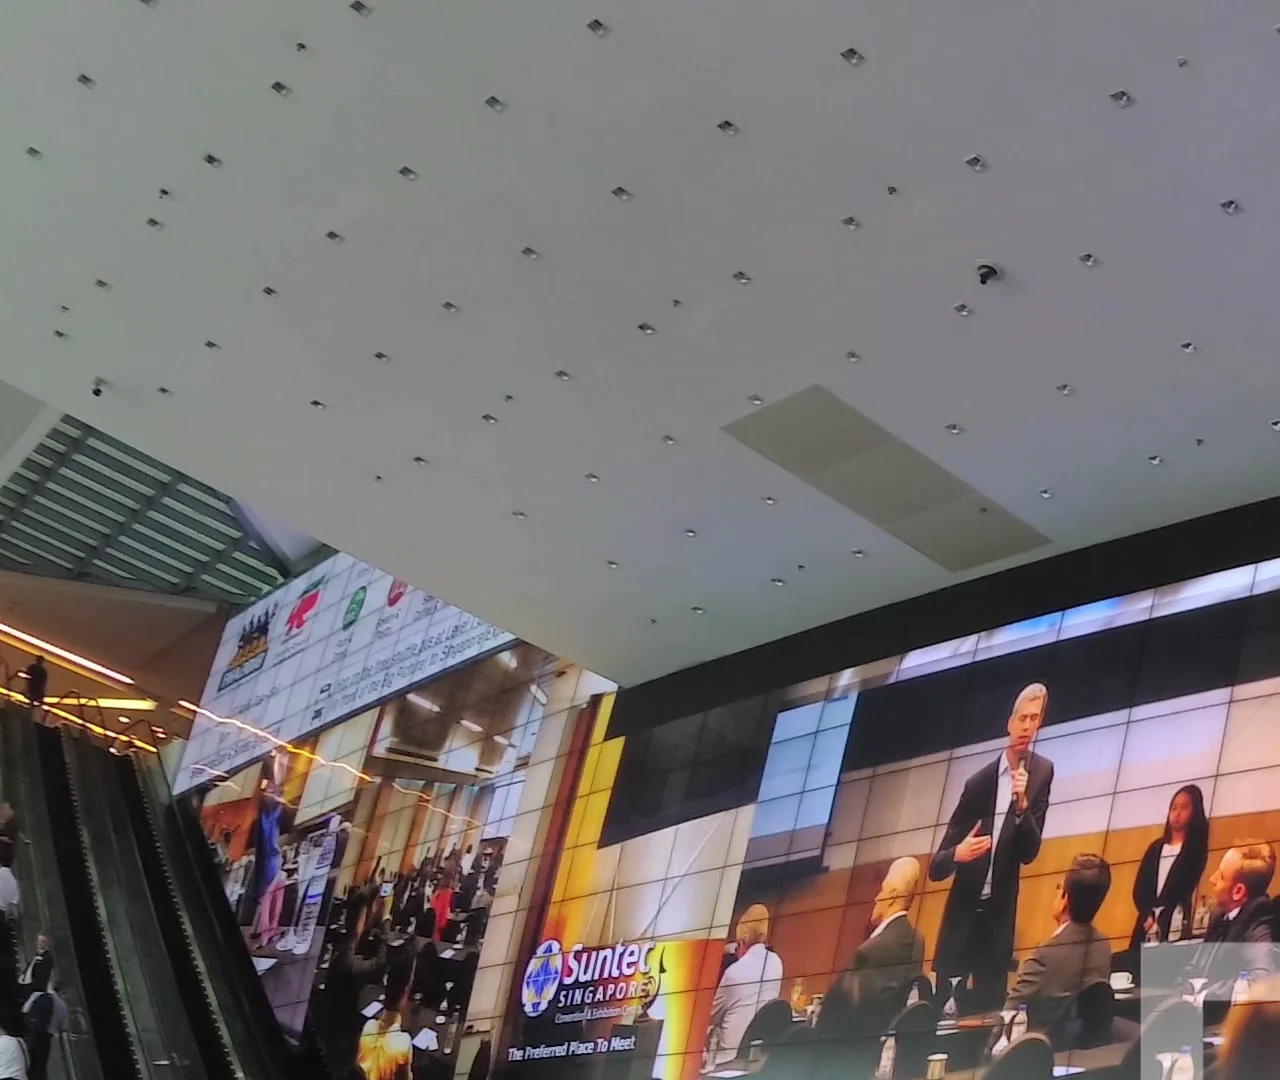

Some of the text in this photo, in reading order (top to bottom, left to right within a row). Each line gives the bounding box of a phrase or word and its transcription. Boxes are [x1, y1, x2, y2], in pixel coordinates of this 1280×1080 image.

[563, 938, 655, 985] Suntec
[557, 979, 650, 1008] SINGAPORE
[508, 1035, 637, 1062] The Preferred Place To Meet
